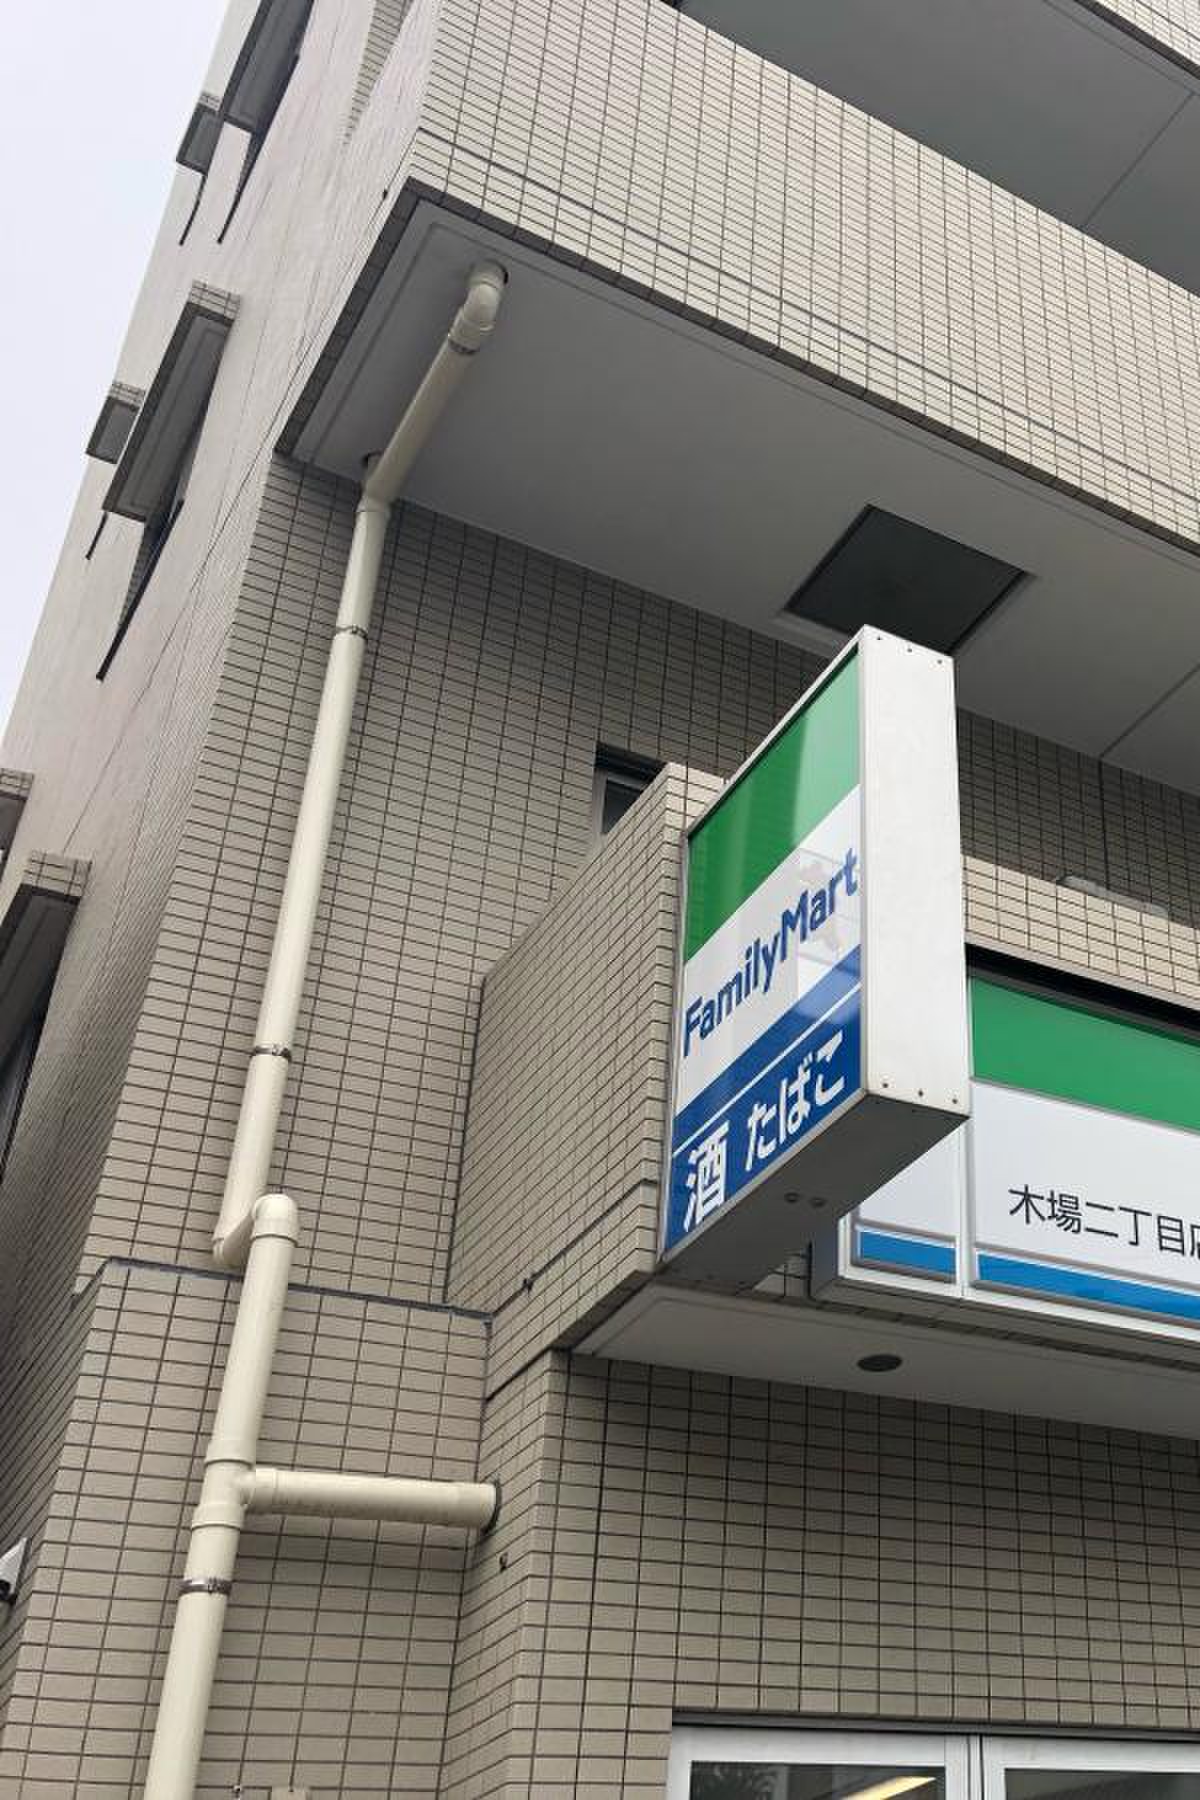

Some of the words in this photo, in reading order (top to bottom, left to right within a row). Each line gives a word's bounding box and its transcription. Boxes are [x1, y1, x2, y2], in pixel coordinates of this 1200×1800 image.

[683, 847, 859, 1058] FamilyMart
[683, 1120, 729, 1232] 酒
[745, 1029, 845, 1172] たばこ
